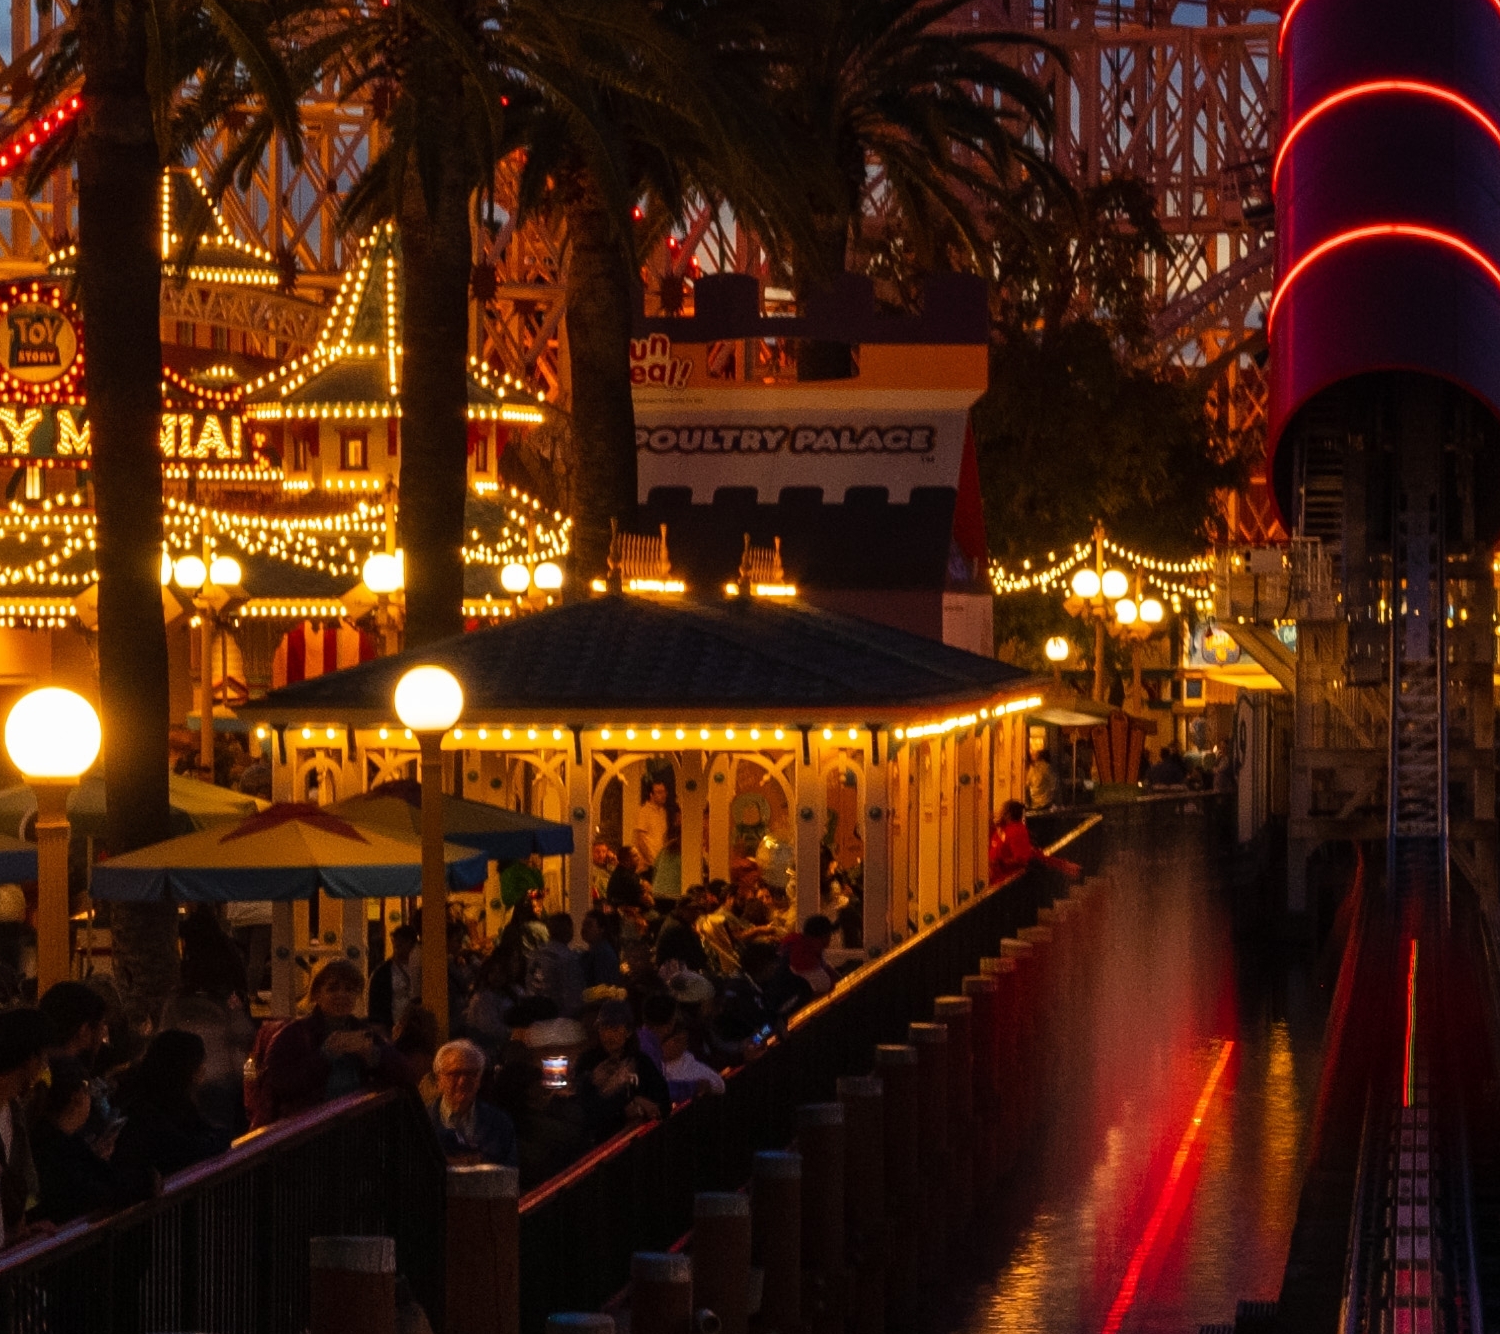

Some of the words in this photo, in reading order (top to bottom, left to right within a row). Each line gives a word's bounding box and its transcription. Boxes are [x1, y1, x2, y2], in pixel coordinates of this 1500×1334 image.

[13, 317, 61, 344] TOY
[18, 349, 57, 363] STORY
[630, 334, 669, 361] un
[792, 426, 934, 453] PALACE
